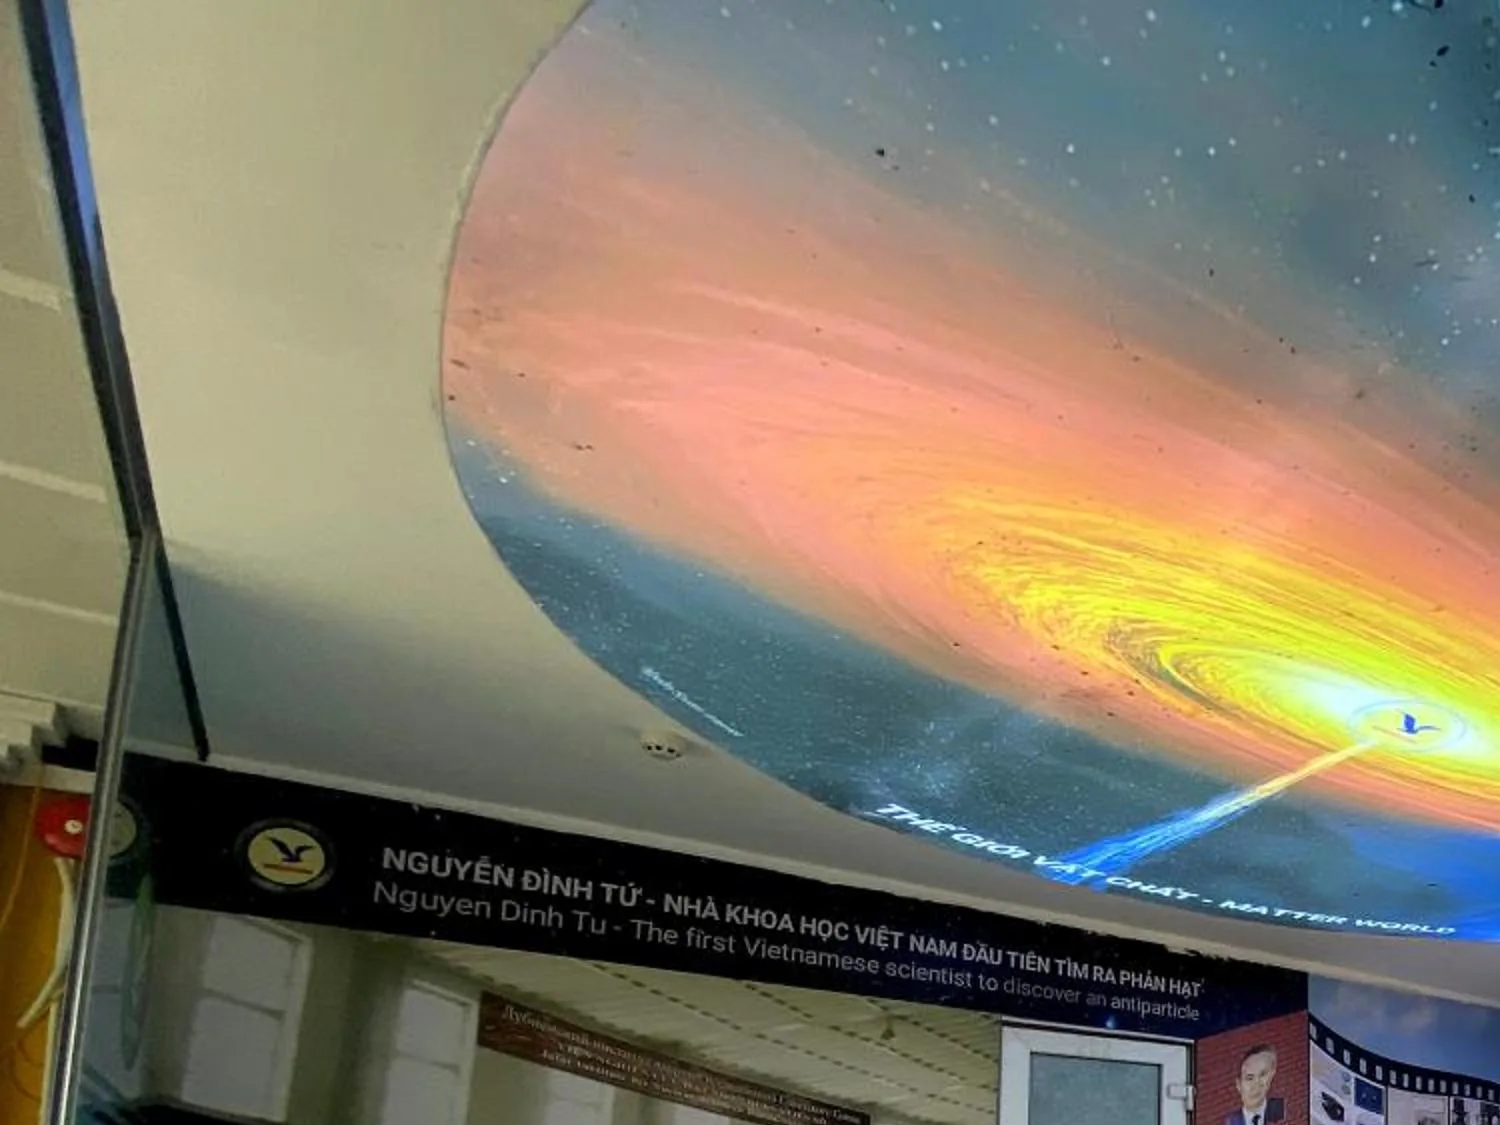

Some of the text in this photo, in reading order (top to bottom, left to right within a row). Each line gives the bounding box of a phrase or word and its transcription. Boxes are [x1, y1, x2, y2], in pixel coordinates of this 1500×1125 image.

[372, 880, 491, 919] Nguyen
[500, 899, 564, 929] Dinh
[572, 909, 606, 934] Tu
[629, 918, 679, 945] The
[686, 927, 736, 954] first
[743, 938, 880, 974] Vietnamese
[885, 961, 972, 988] scientist
[979, 973, 999, 992] to
[1003, 976, 1081, 1002] discover
[1086, 992, 1107, 1007] an
[1111, 995, 1200, 1021] antiparticle
[383, 847, 515, 888] NGUYỄN
[521, 866, 593, 900] ĐÌNH
[600, 881, 643, 907] TỨ
[662, 893, 720, 921] NHÀ
[725, 903, 795, 933] KHOA
[799, 916, 849, 942] HỌC
[854, 925, 904, 950] VIỆT
[909, 933, 957, 960] NAM
[1055, 959, 1089, 980] TÌM
[1093, 967, 1116, 985] RA
[1218, 900, 1348, 924] MATTER
[1355, 918, 1456, 935] WORLD
